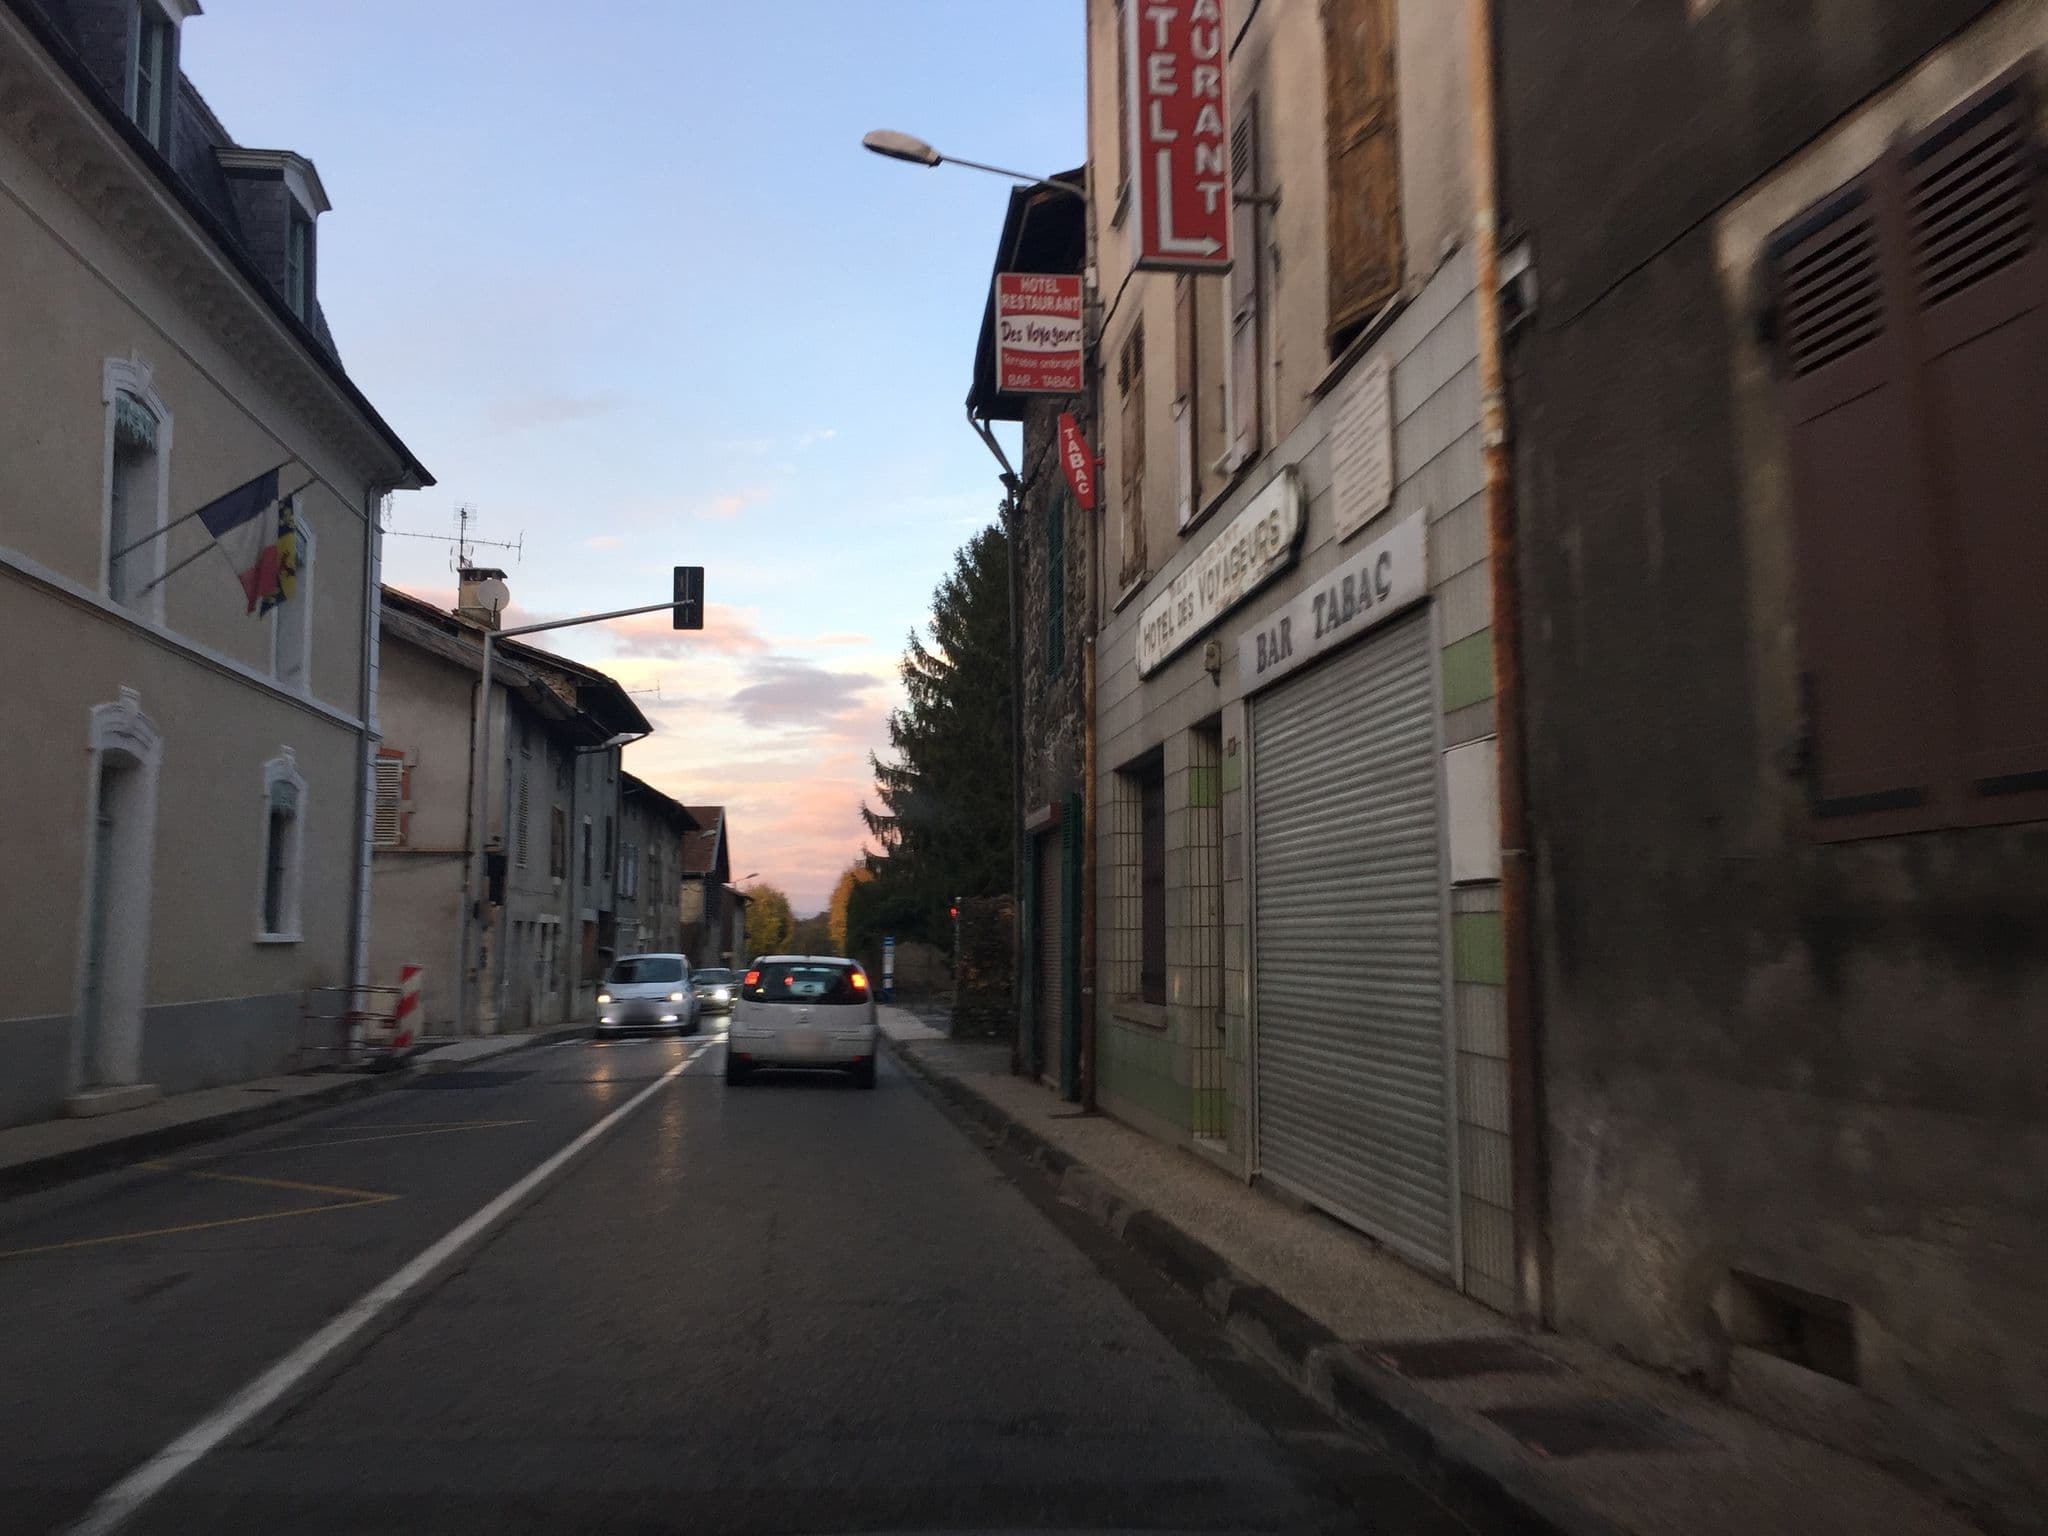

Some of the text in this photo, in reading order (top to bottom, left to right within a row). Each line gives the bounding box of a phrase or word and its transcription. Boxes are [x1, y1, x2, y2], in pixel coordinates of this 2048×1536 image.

[1146, 0, 1178, 142] TEL
[1001, 294, 1080, 312] RESTAURANT
[1001, 321, 1081, 347] Des Voyageurs
[1008, 374, 1031, 387] BAR
[1064, 428, 1090, 494] TABAC
[1143, 606, 1175, 657] HOTEL
[1177, 592, 1194, 629] DES
[1198, 508, 1280, 612] VOYAGEURS
[1256, 616, 1293, 674] BAR
[1312, 551, 1393, 639] TABAC
